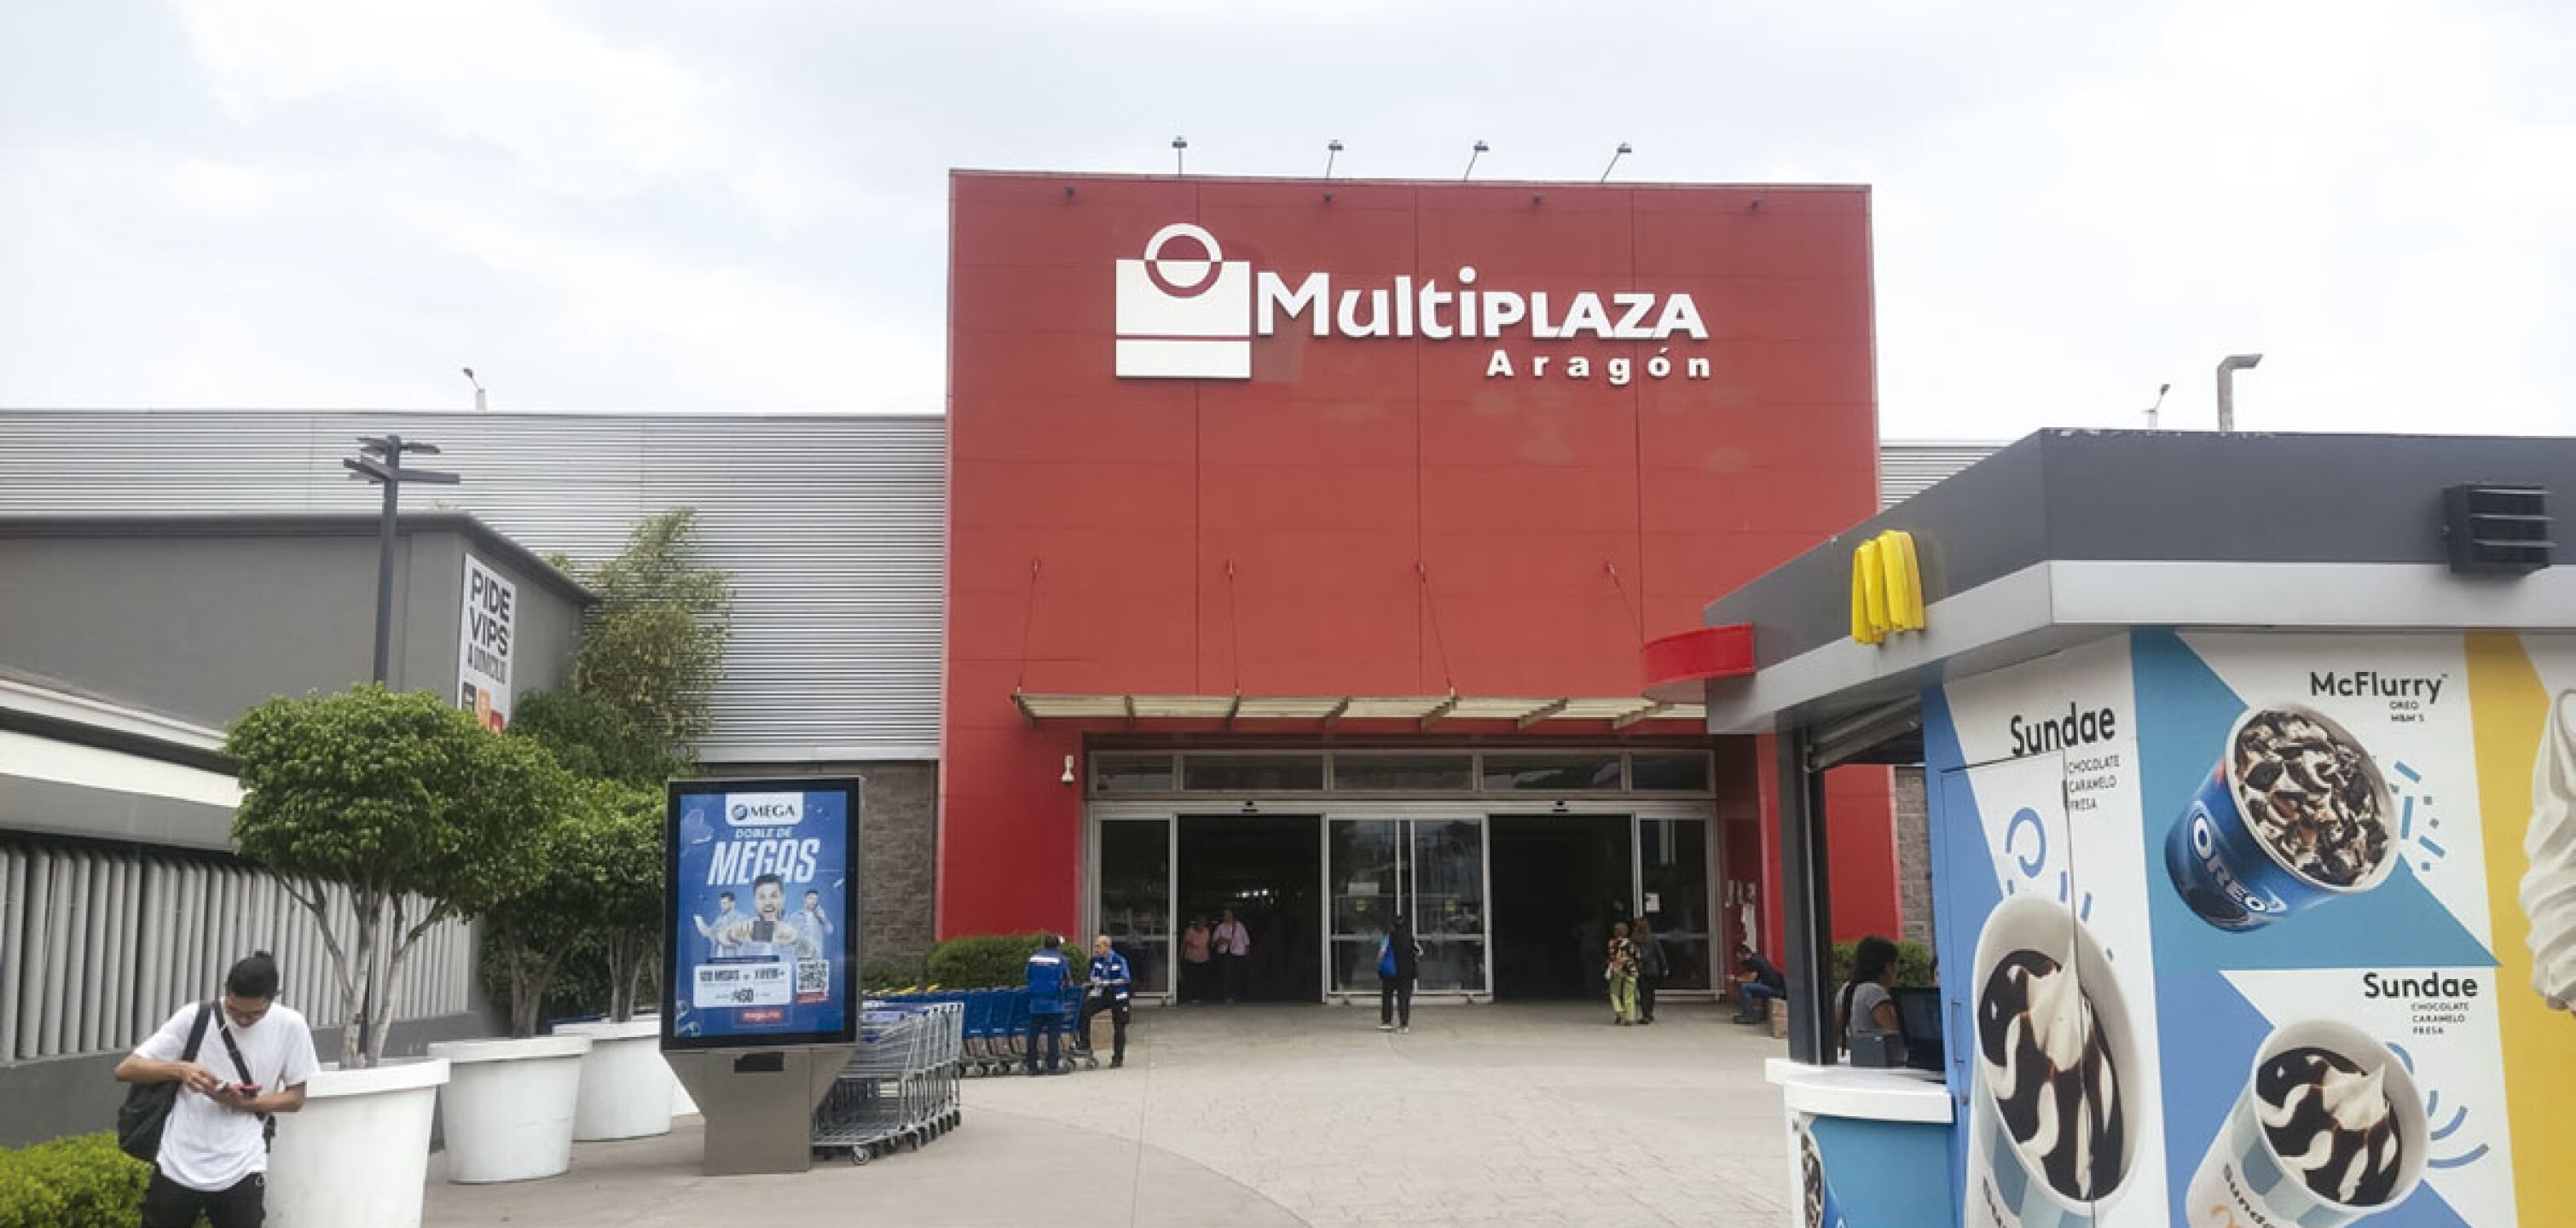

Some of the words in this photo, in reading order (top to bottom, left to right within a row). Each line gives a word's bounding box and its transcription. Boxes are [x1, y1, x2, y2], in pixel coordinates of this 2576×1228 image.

[1486, 347, 1711, 385] Aragón
[472, 568, 512, 623] PIDE
[469, 605, 507, 656] VIPS
[2388, 700, 2420, 710] OREO
[2010, 702, 2116, 758] Sundae
[2069, 755, 2120, 774] CHOCOLATE
[2069, 774, 2117, 793] CARAMELO
[750, 804, 796, 818] MEGA
[706, 837, 821, 886] MEGAS
[2192, 815, 2266, 912] OREO
[2363, 970, 2478, 999] Sundae
[2410, 1002, 2469, 1012] CHOCOLATE
[2411, 1013, 2466, 1023] CARAMELO
[2412, 1025, 2444, 1034] FRESA
